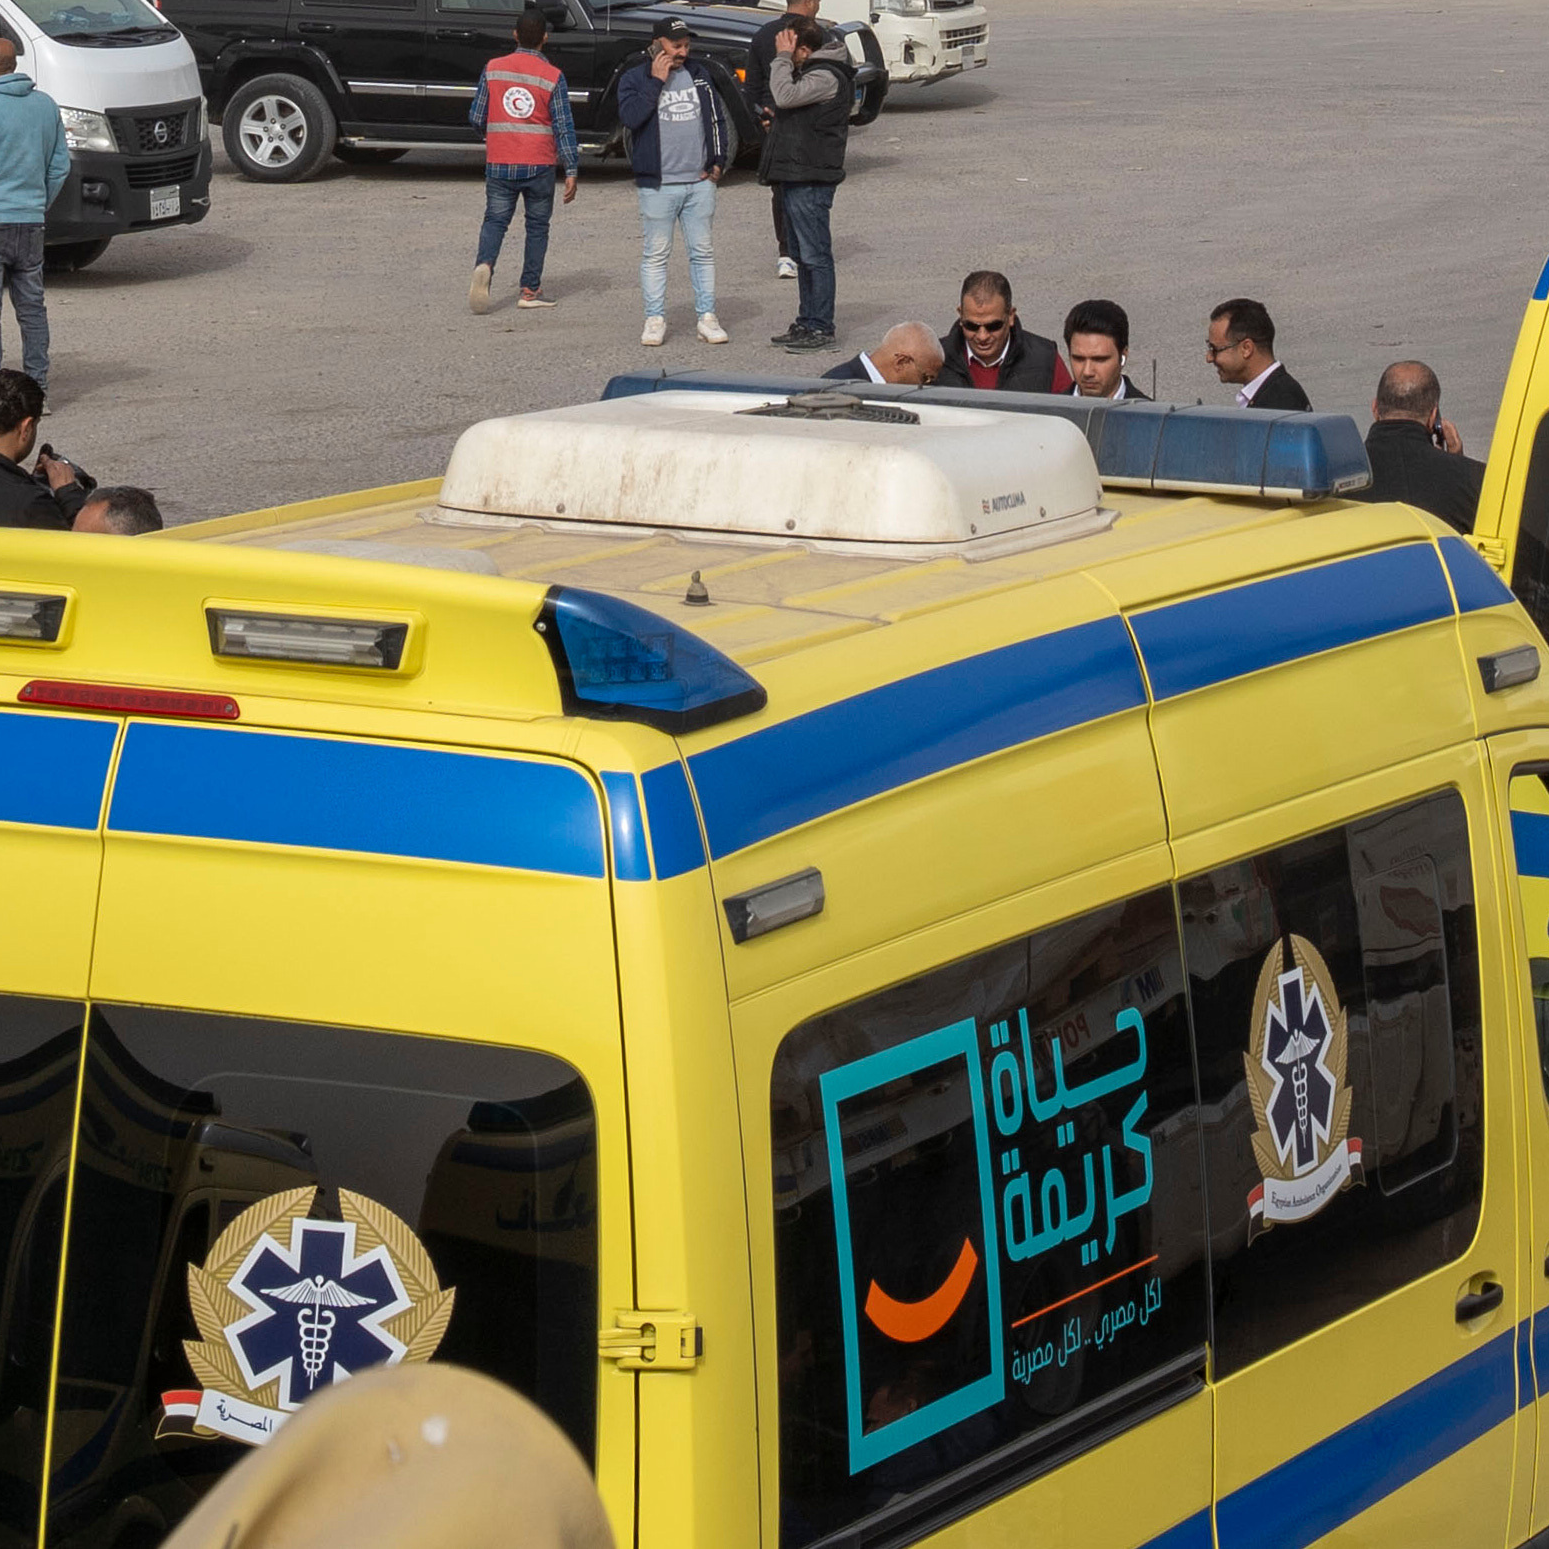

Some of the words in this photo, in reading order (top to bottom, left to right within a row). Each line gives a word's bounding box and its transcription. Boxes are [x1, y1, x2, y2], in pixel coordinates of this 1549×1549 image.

[990, 1007, 1147, 1147] حياة
[1002, 1090, 1154, 1267] كريمة
[1094, 1301, 1136, 1351] مصري
[1139, 1276, 1162, 1326] لكل
[1012, 1342, 1054, 1385] مصرية
[1058, 1316, 1082, 1368] لكل
[216, 1399, 274, 1433] المصرية
